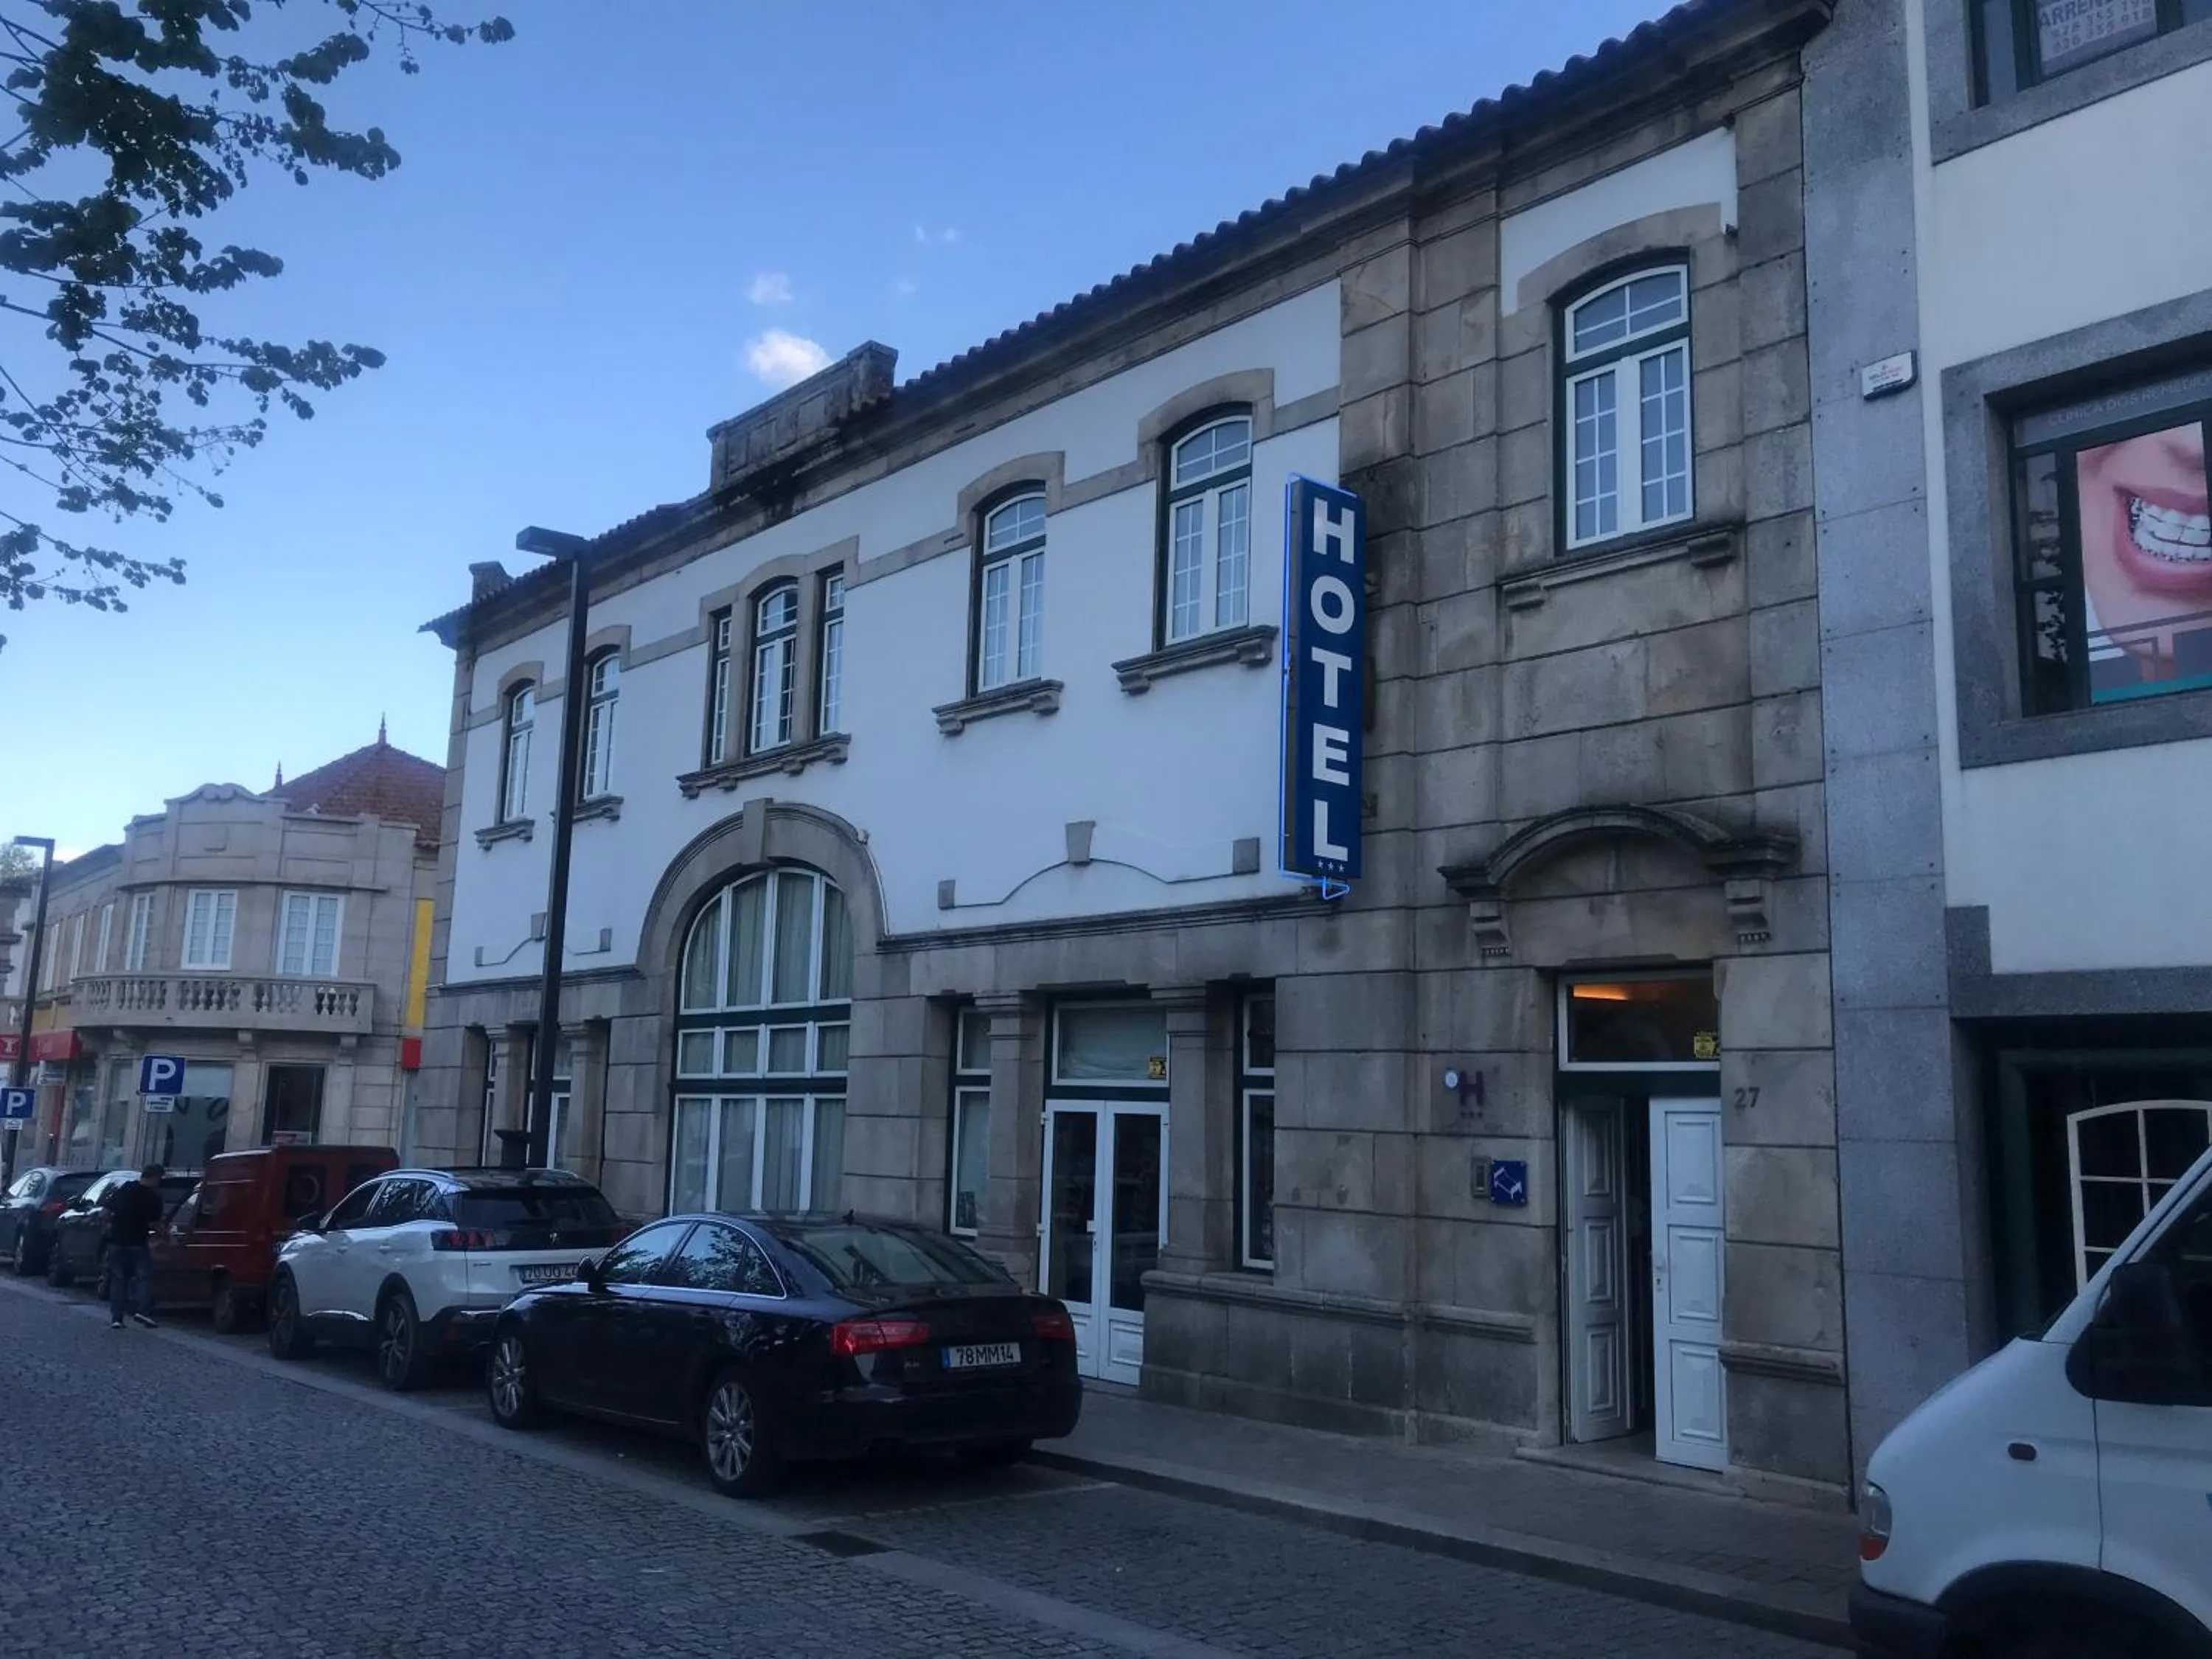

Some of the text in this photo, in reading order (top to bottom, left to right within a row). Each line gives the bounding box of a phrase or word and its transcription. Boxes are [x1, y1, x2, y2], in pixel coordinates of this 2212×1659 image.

[2106, 392, 2138, 413] DOS
[1310, 496, 1355, 862] HOTEL
[148, 1058, 176, 1091] P
[1459, 1070, 1484, 1107] H
[1734, 1086, 1761, 1110] 27
[6, 1091, 27, 1116] P
[956, 1344, 1015, 1366] 78MM14
